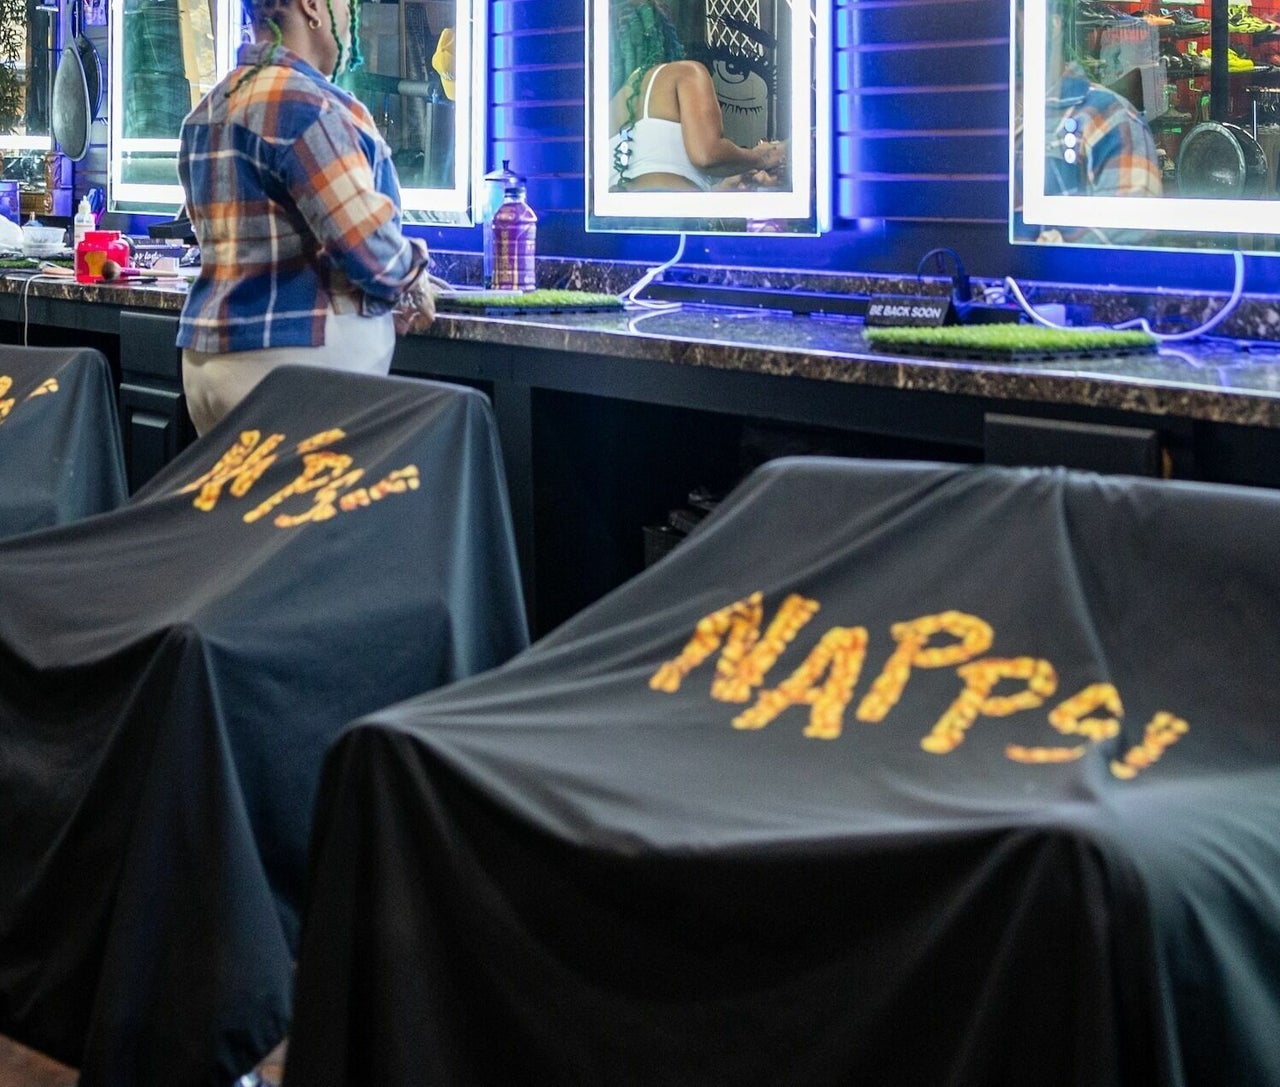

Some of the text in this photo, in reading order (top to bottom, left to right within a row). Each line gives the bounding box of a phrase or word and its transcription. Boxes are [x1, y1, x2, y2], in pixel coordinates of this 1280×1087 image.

[868, 304, 942, 319] BE BACK SOON
